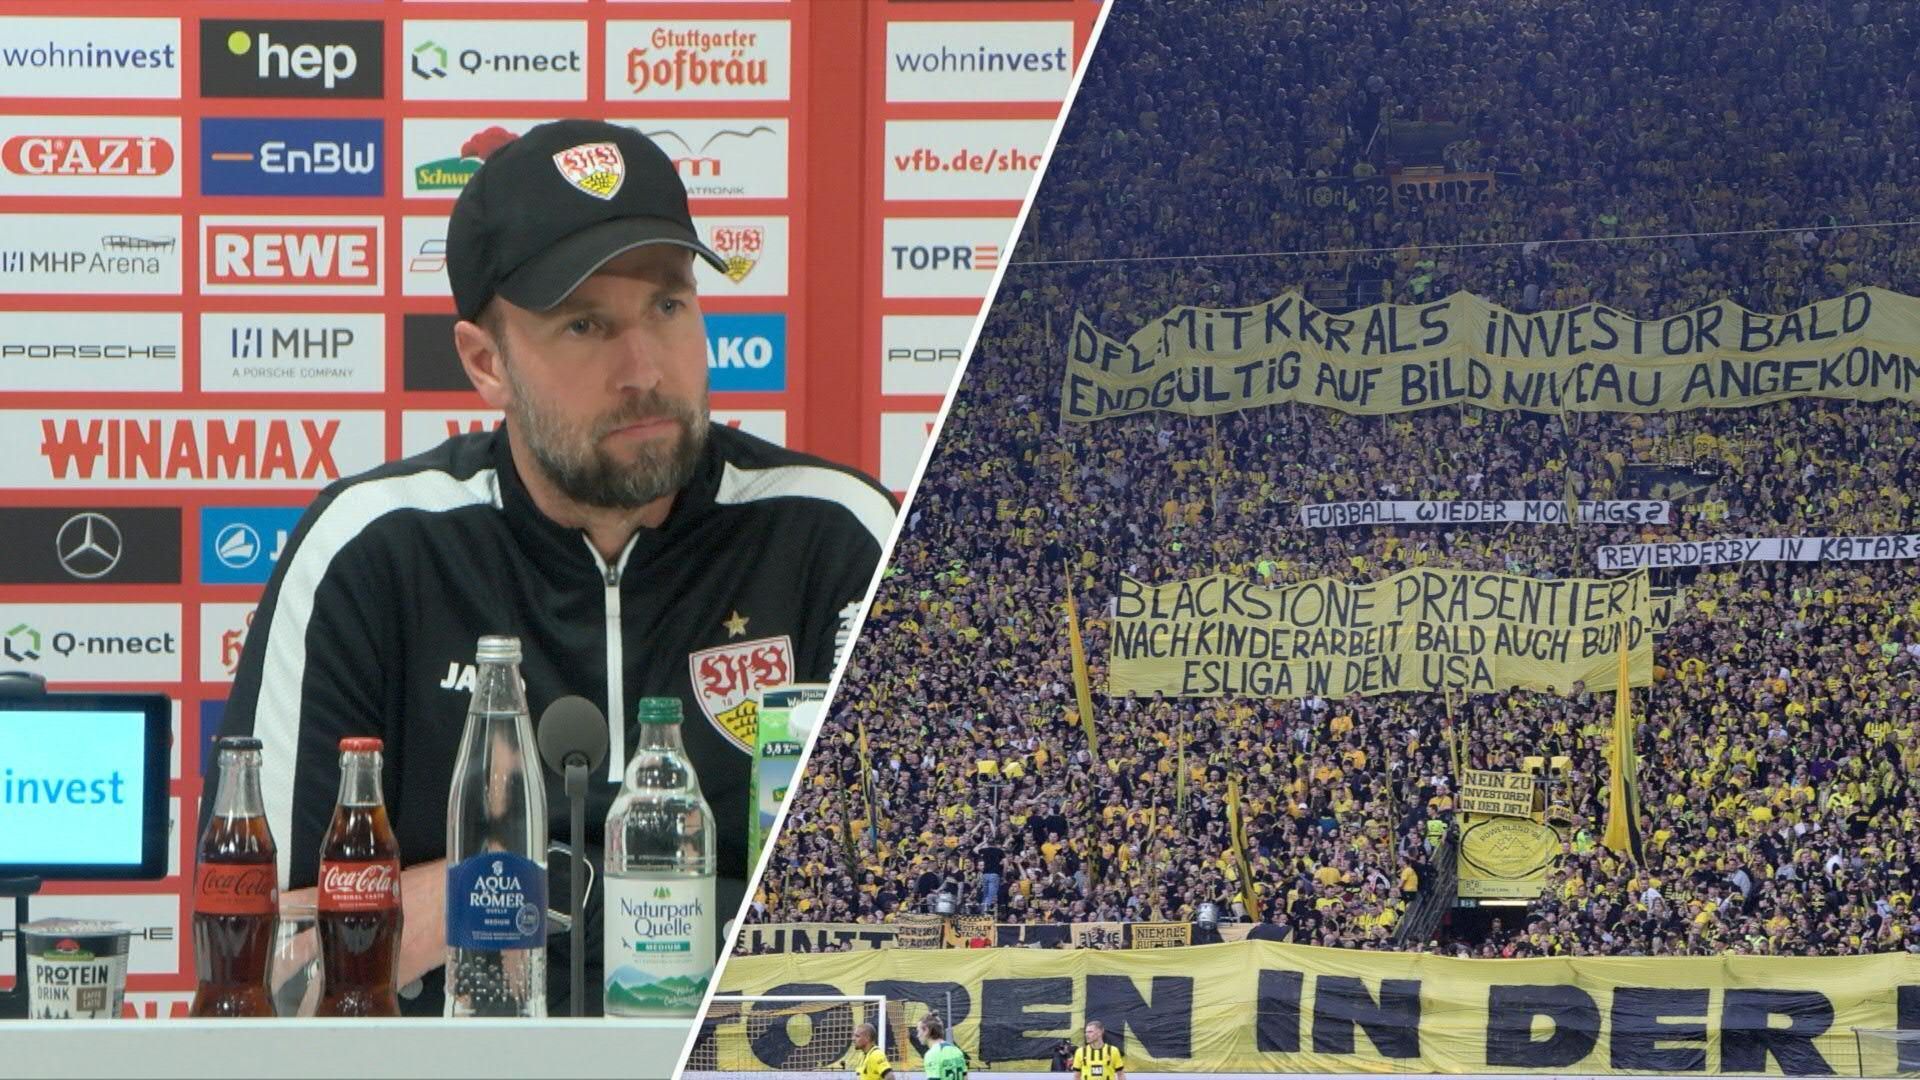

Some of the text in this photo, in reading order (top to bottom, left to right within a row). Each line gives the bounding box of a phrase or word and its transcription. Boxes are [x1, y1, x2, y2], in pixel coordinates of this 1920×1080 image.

[651, 28, 757, 51] Stuttgarter
[3, 43, 175, 69] wohninvest
[259, 33, 358, 88] hep
[896, 46, 1067, 73] wohninvest
[626, 46, 767, 94] Hofbräu
[259, 141, 375, 174] EnBW
[215, 234, 370, 278] REWE
[1741, 291, 1871, 351] BALD
[3, 345, 176, 358] PORSCHE
[272, 329, 355, 358] MHP
[233, 368, 355, 378] A PORSCHE COMPANY
[1315, 362, 1382, 405] AUF
[40, 420, 341, 480] WINAMAX
[1416, 502, 1507, 520] WIEDER
[1602, 540, 1762, 567] REVIERDERBY
[1779, 540, 1804, 559] IN
[1115, 579, 1377, 628] BLACKSTONE
[1416, 622, 1486, 655] BALD
[1494, 622, 1571, 663] AUCH
[1183, 654, 1494, 695] ESLIGA IN DEN USA
[5, 769, 124, 804] invest
[1466, 772, 1531, 789] NEIN ZU
[1464, 788, 1531, 802] INVESTOREN
[1464, 800, 1529, 815] IN DER DFL!
[324, 865, 391, 893] Coca-Cola
[474, 876, 522, 894] AQUA
[470, 891, 525, 907] RÖMER
[620, 897, 703, 920] Naturpark
[635, 918, 692, 938] Quelle
[1137, 922, 1186, 934] NIEMALS
[36, 965, 109, 985] PROTEIN
[38, 987, 70, 1001] DRINK
[1257, 969, 1422, 1060] IN
[1487, 985, 1838, 1076] DER
